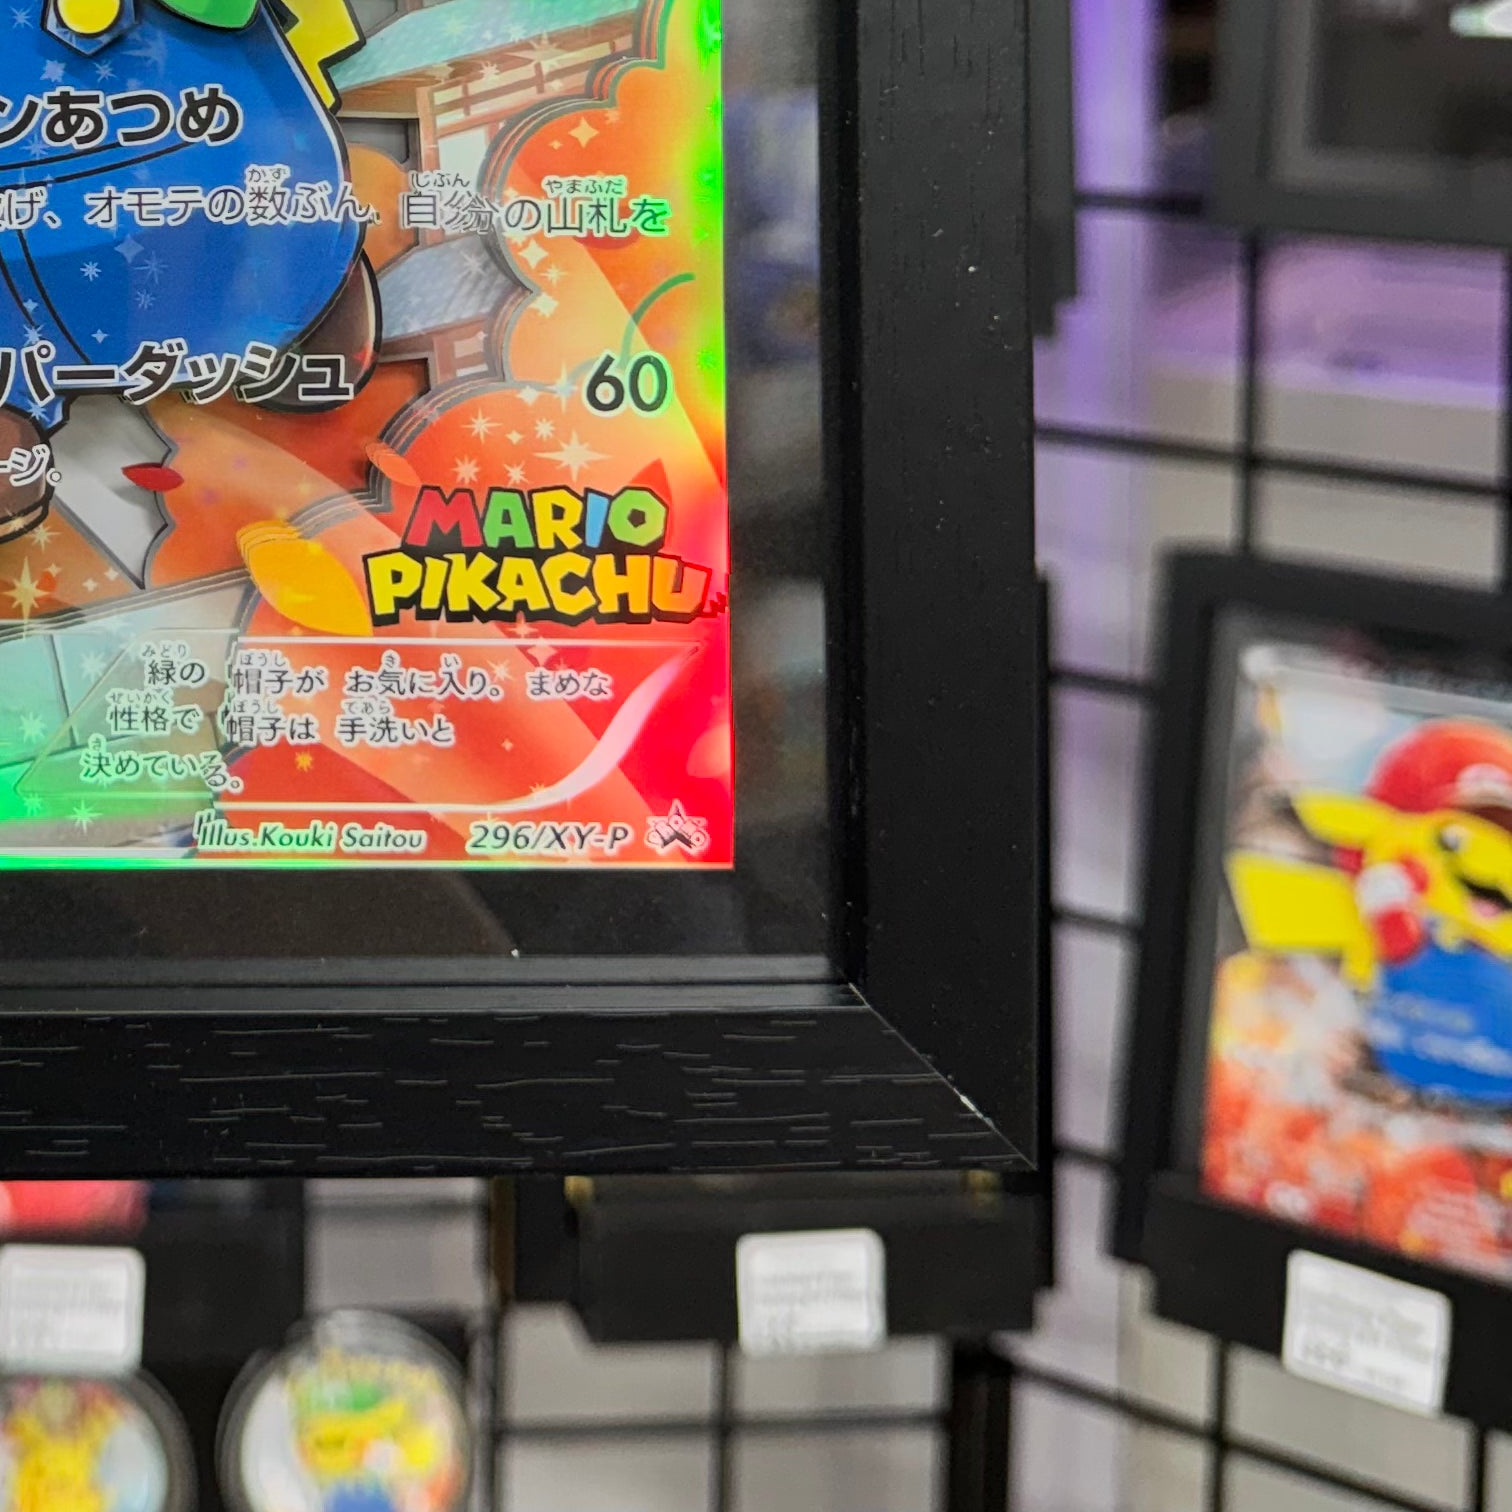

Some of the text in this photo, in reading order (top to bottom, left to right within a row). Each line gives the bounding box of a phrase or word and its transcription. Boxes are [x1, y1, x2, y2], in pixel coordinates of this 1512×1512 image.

[586, 353, 668, 412] 60
[402, 485, 669, 550] MARIO
[363, 550, 714, 626] PIKACHU
[528, 671, 610, 697] まめな
[342, 824, 424, 849] Saitou
[470, 824, 630, 850] 296/XY-P
